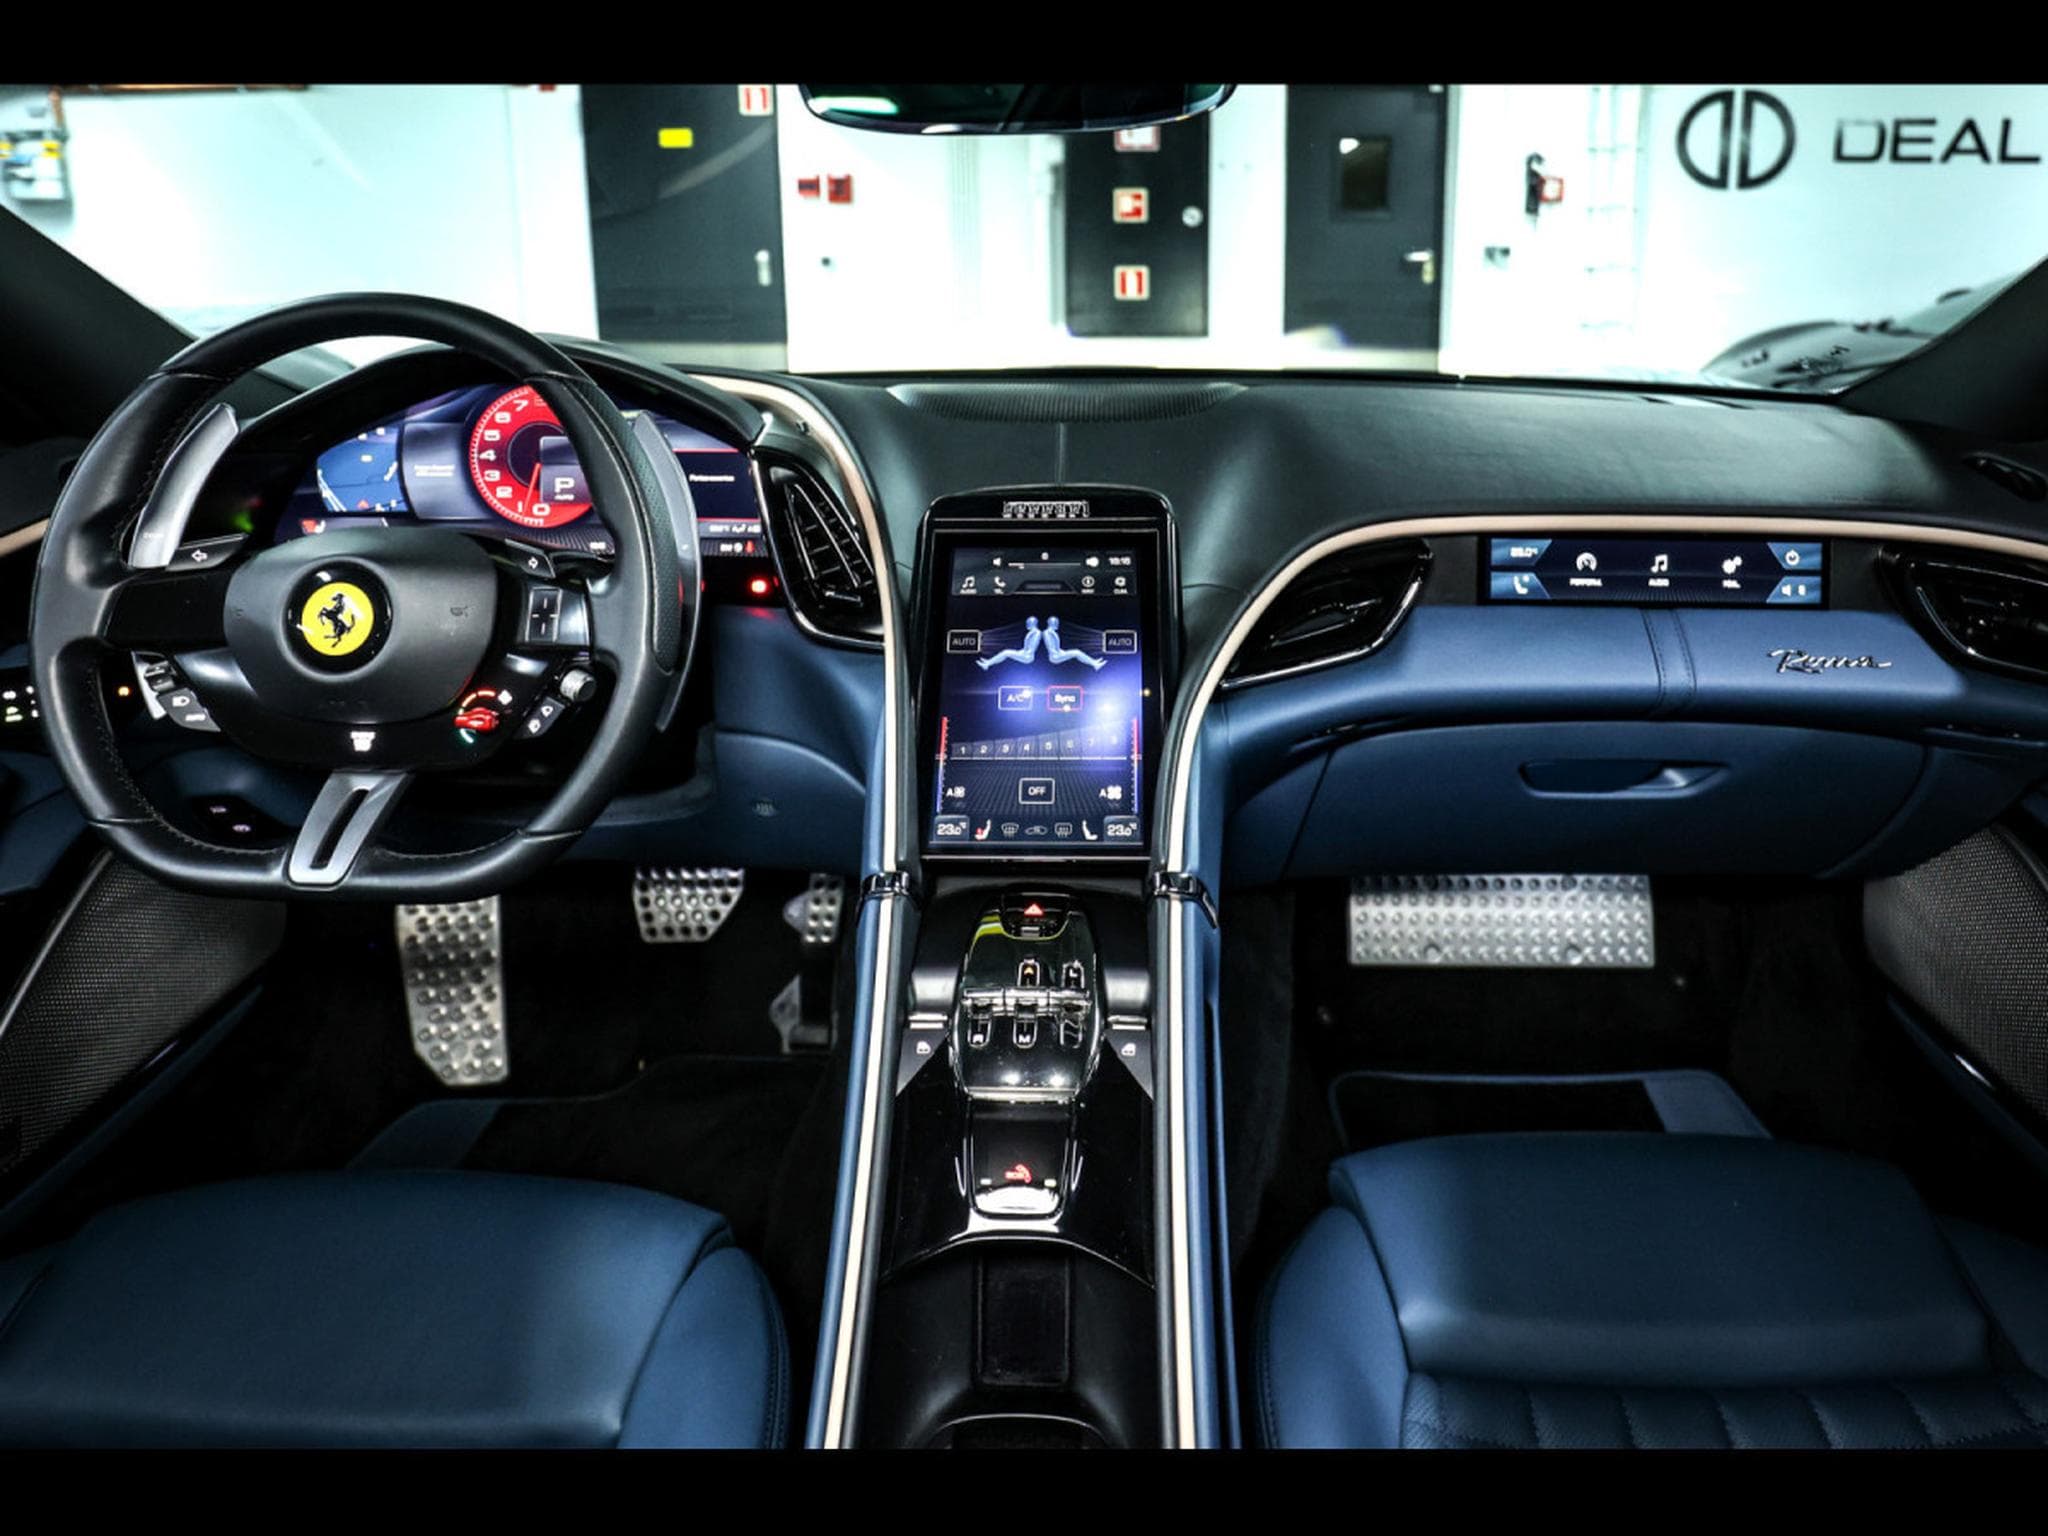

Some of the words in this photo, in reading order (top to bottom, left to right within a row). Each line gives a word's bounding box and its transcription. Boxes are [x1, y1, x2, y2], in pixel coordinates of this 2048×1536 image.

[1833, 117, 2041, 164] DEAL
[554, 477, 575, 493] P
[952, 638, 977, 646] AUTO
[1108, 638, 1132, 646] AUTO
[1028, 786, 1046, 796] OFF
